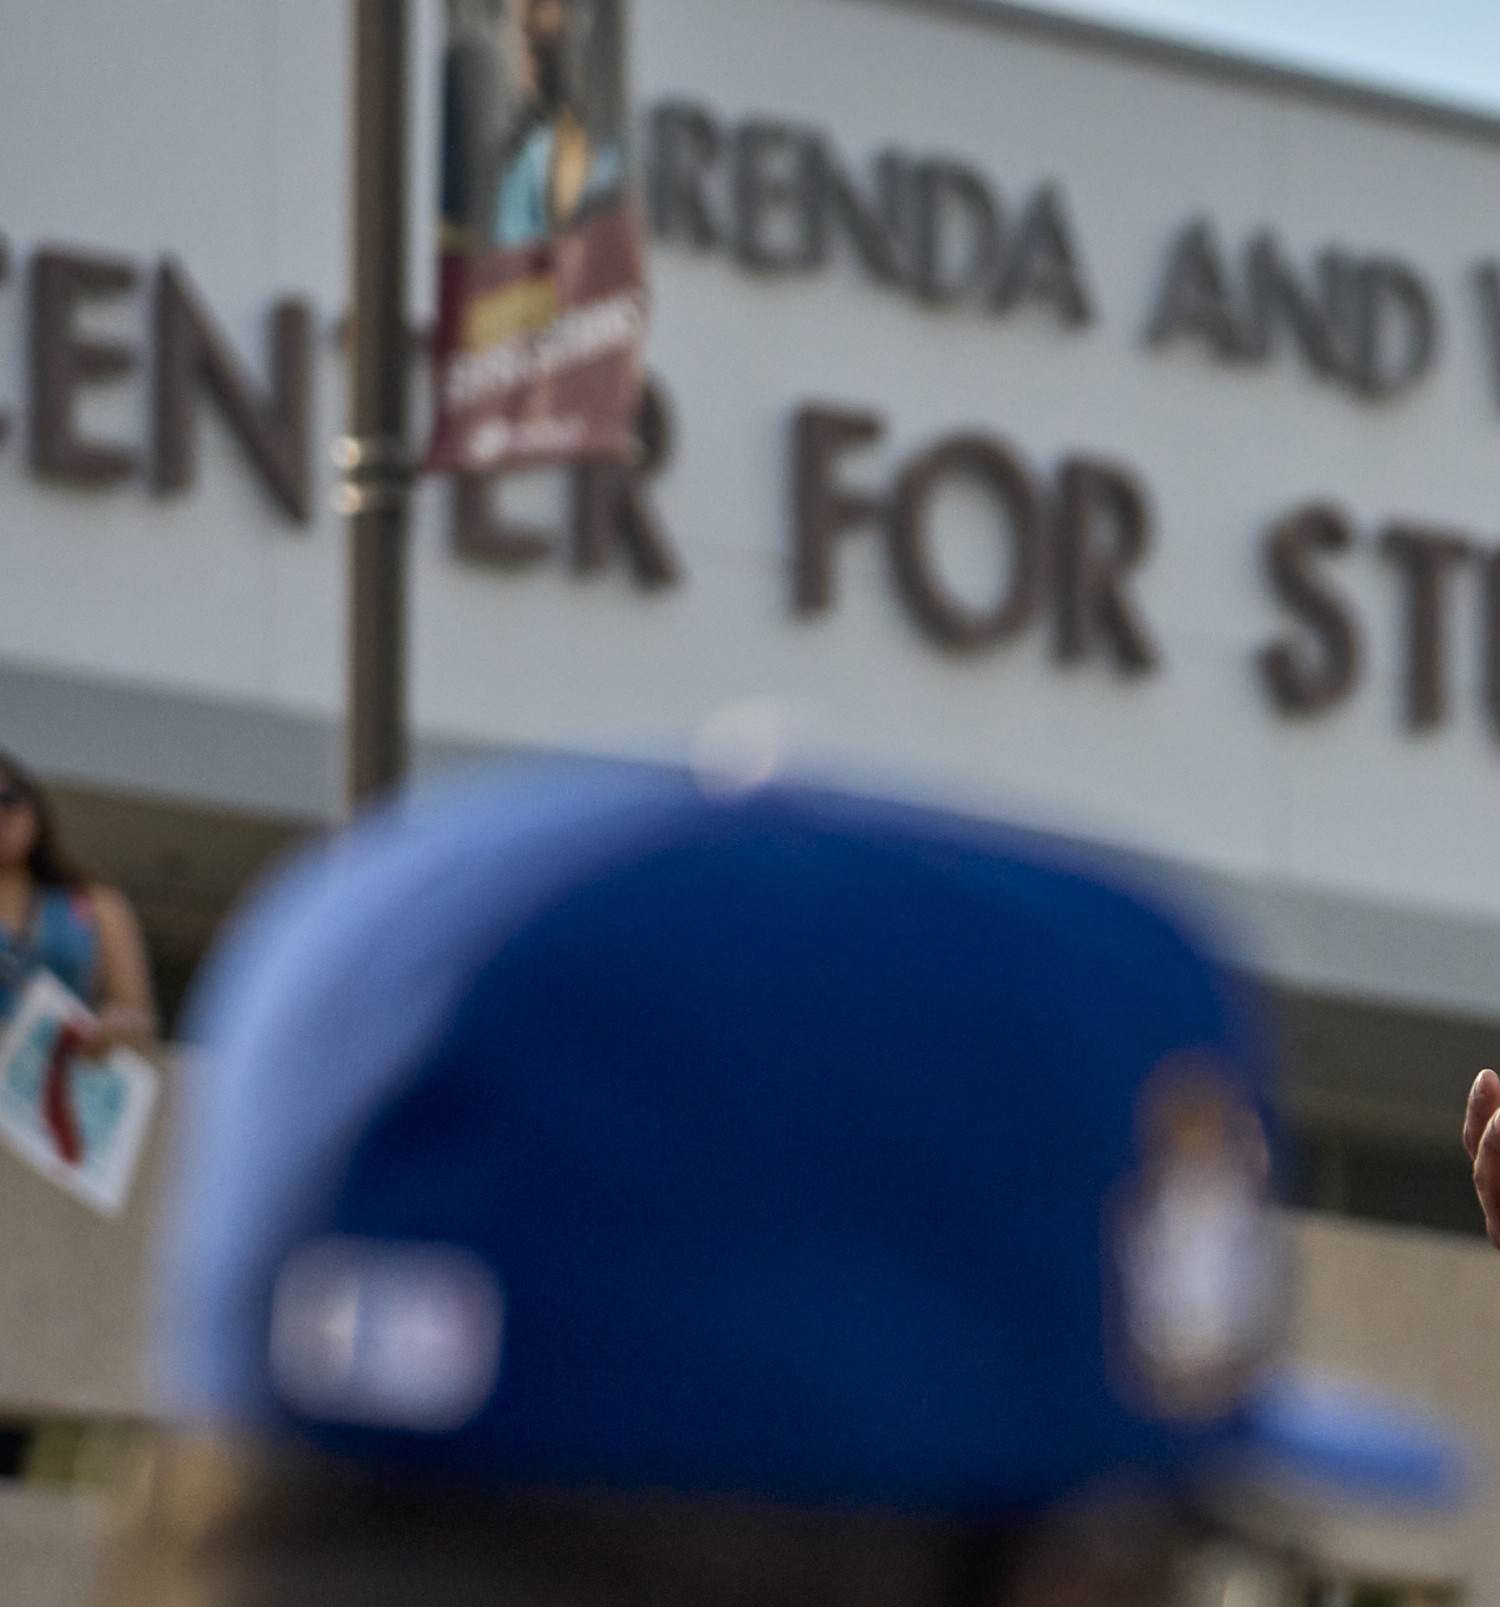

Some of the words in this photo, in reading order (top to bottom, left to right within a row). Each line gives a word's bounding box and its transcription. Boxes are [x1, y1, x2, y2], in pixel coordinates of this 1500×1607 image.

[648, 94, 1096, 334] RENDA
[1141, 214, 1441, 410] AND
[782, 400, 1163, 688] FOR
